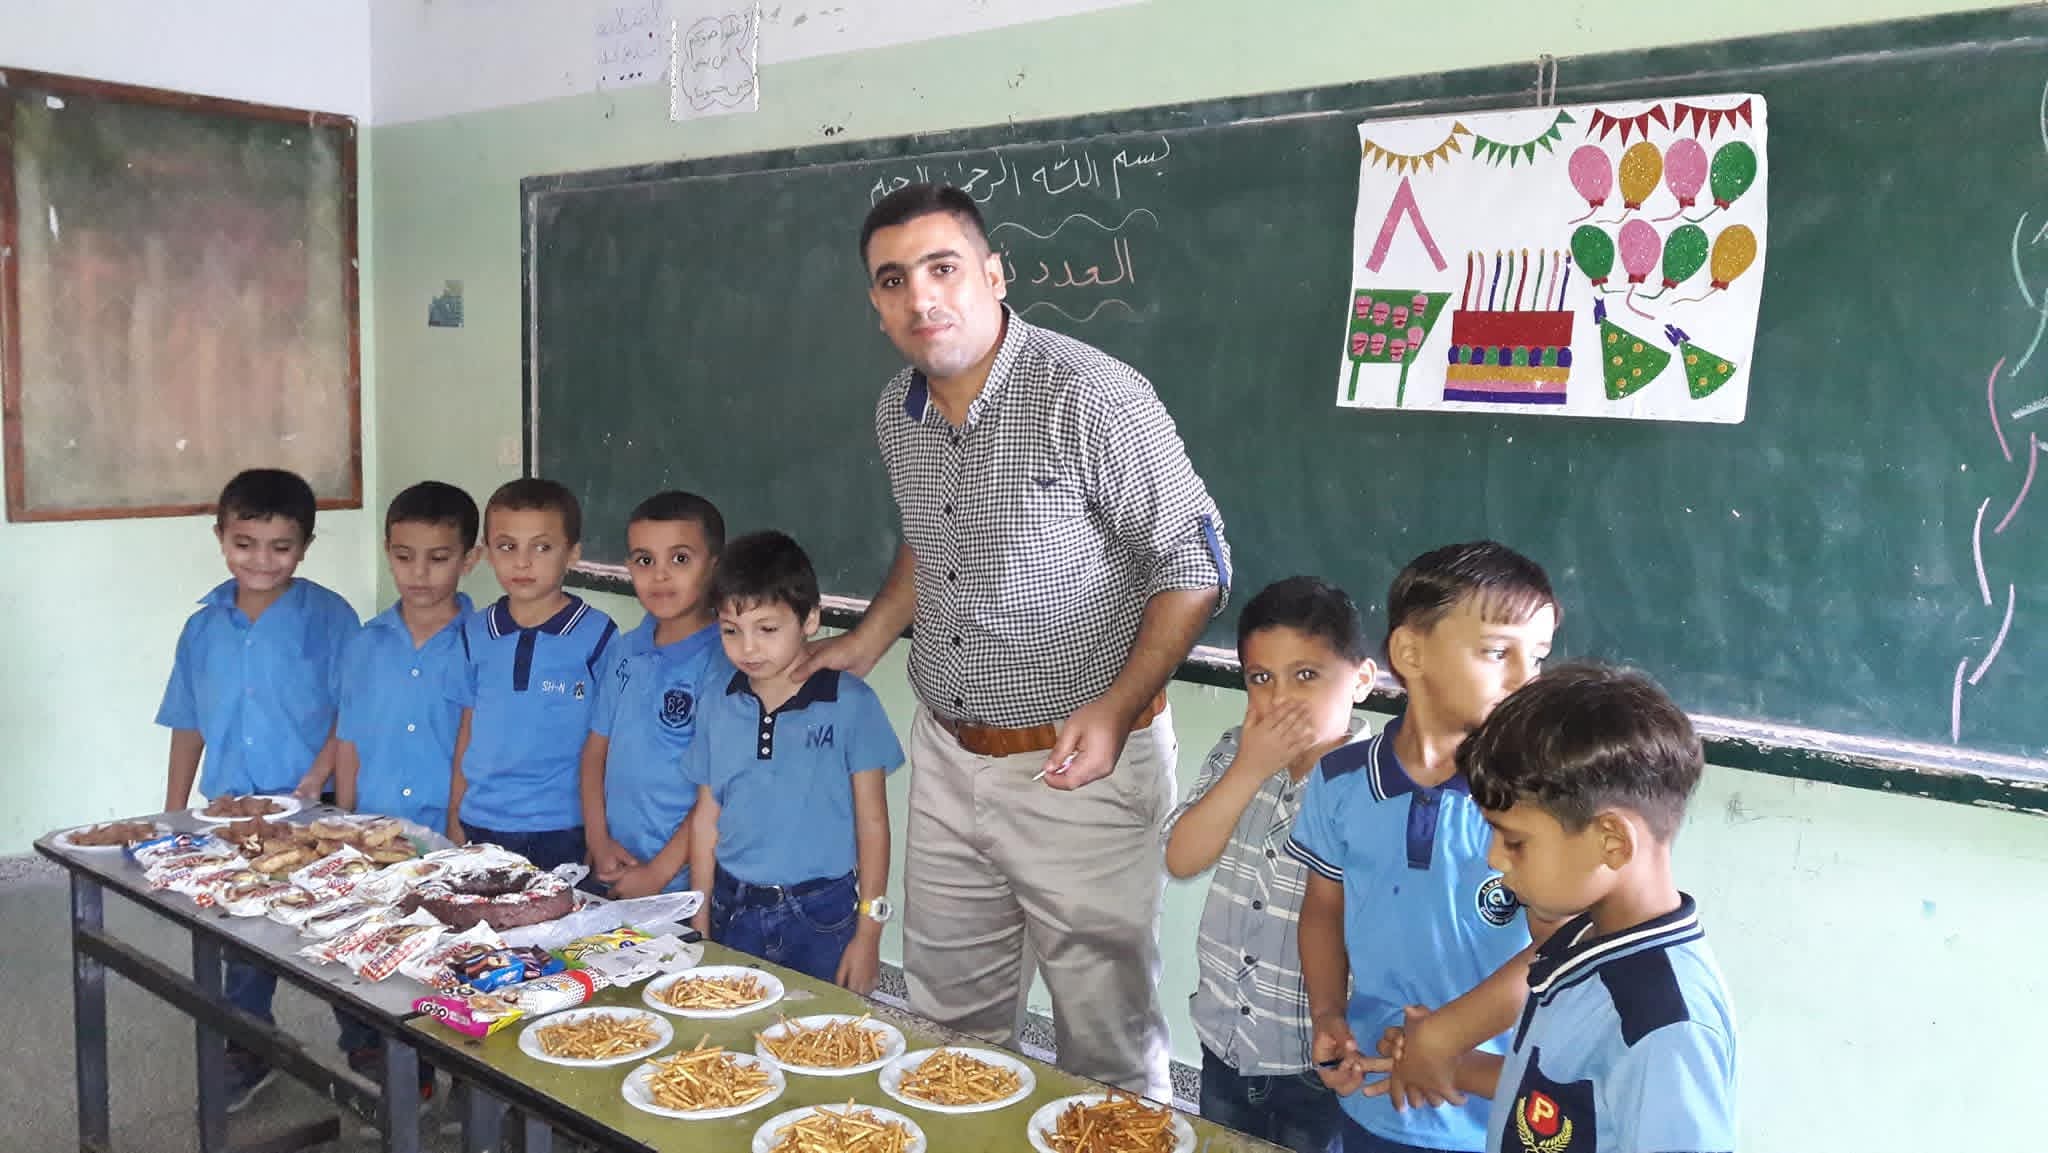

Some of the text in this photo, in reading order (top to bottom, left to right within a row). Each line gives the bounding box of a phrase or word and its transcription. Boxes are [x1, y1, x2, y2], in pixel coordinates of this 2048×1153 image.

[1112, 135, 1171, 200] بسم
[1031, 236, 1136, 288] العدد
[1532, 1097, 1554, 1123] P
